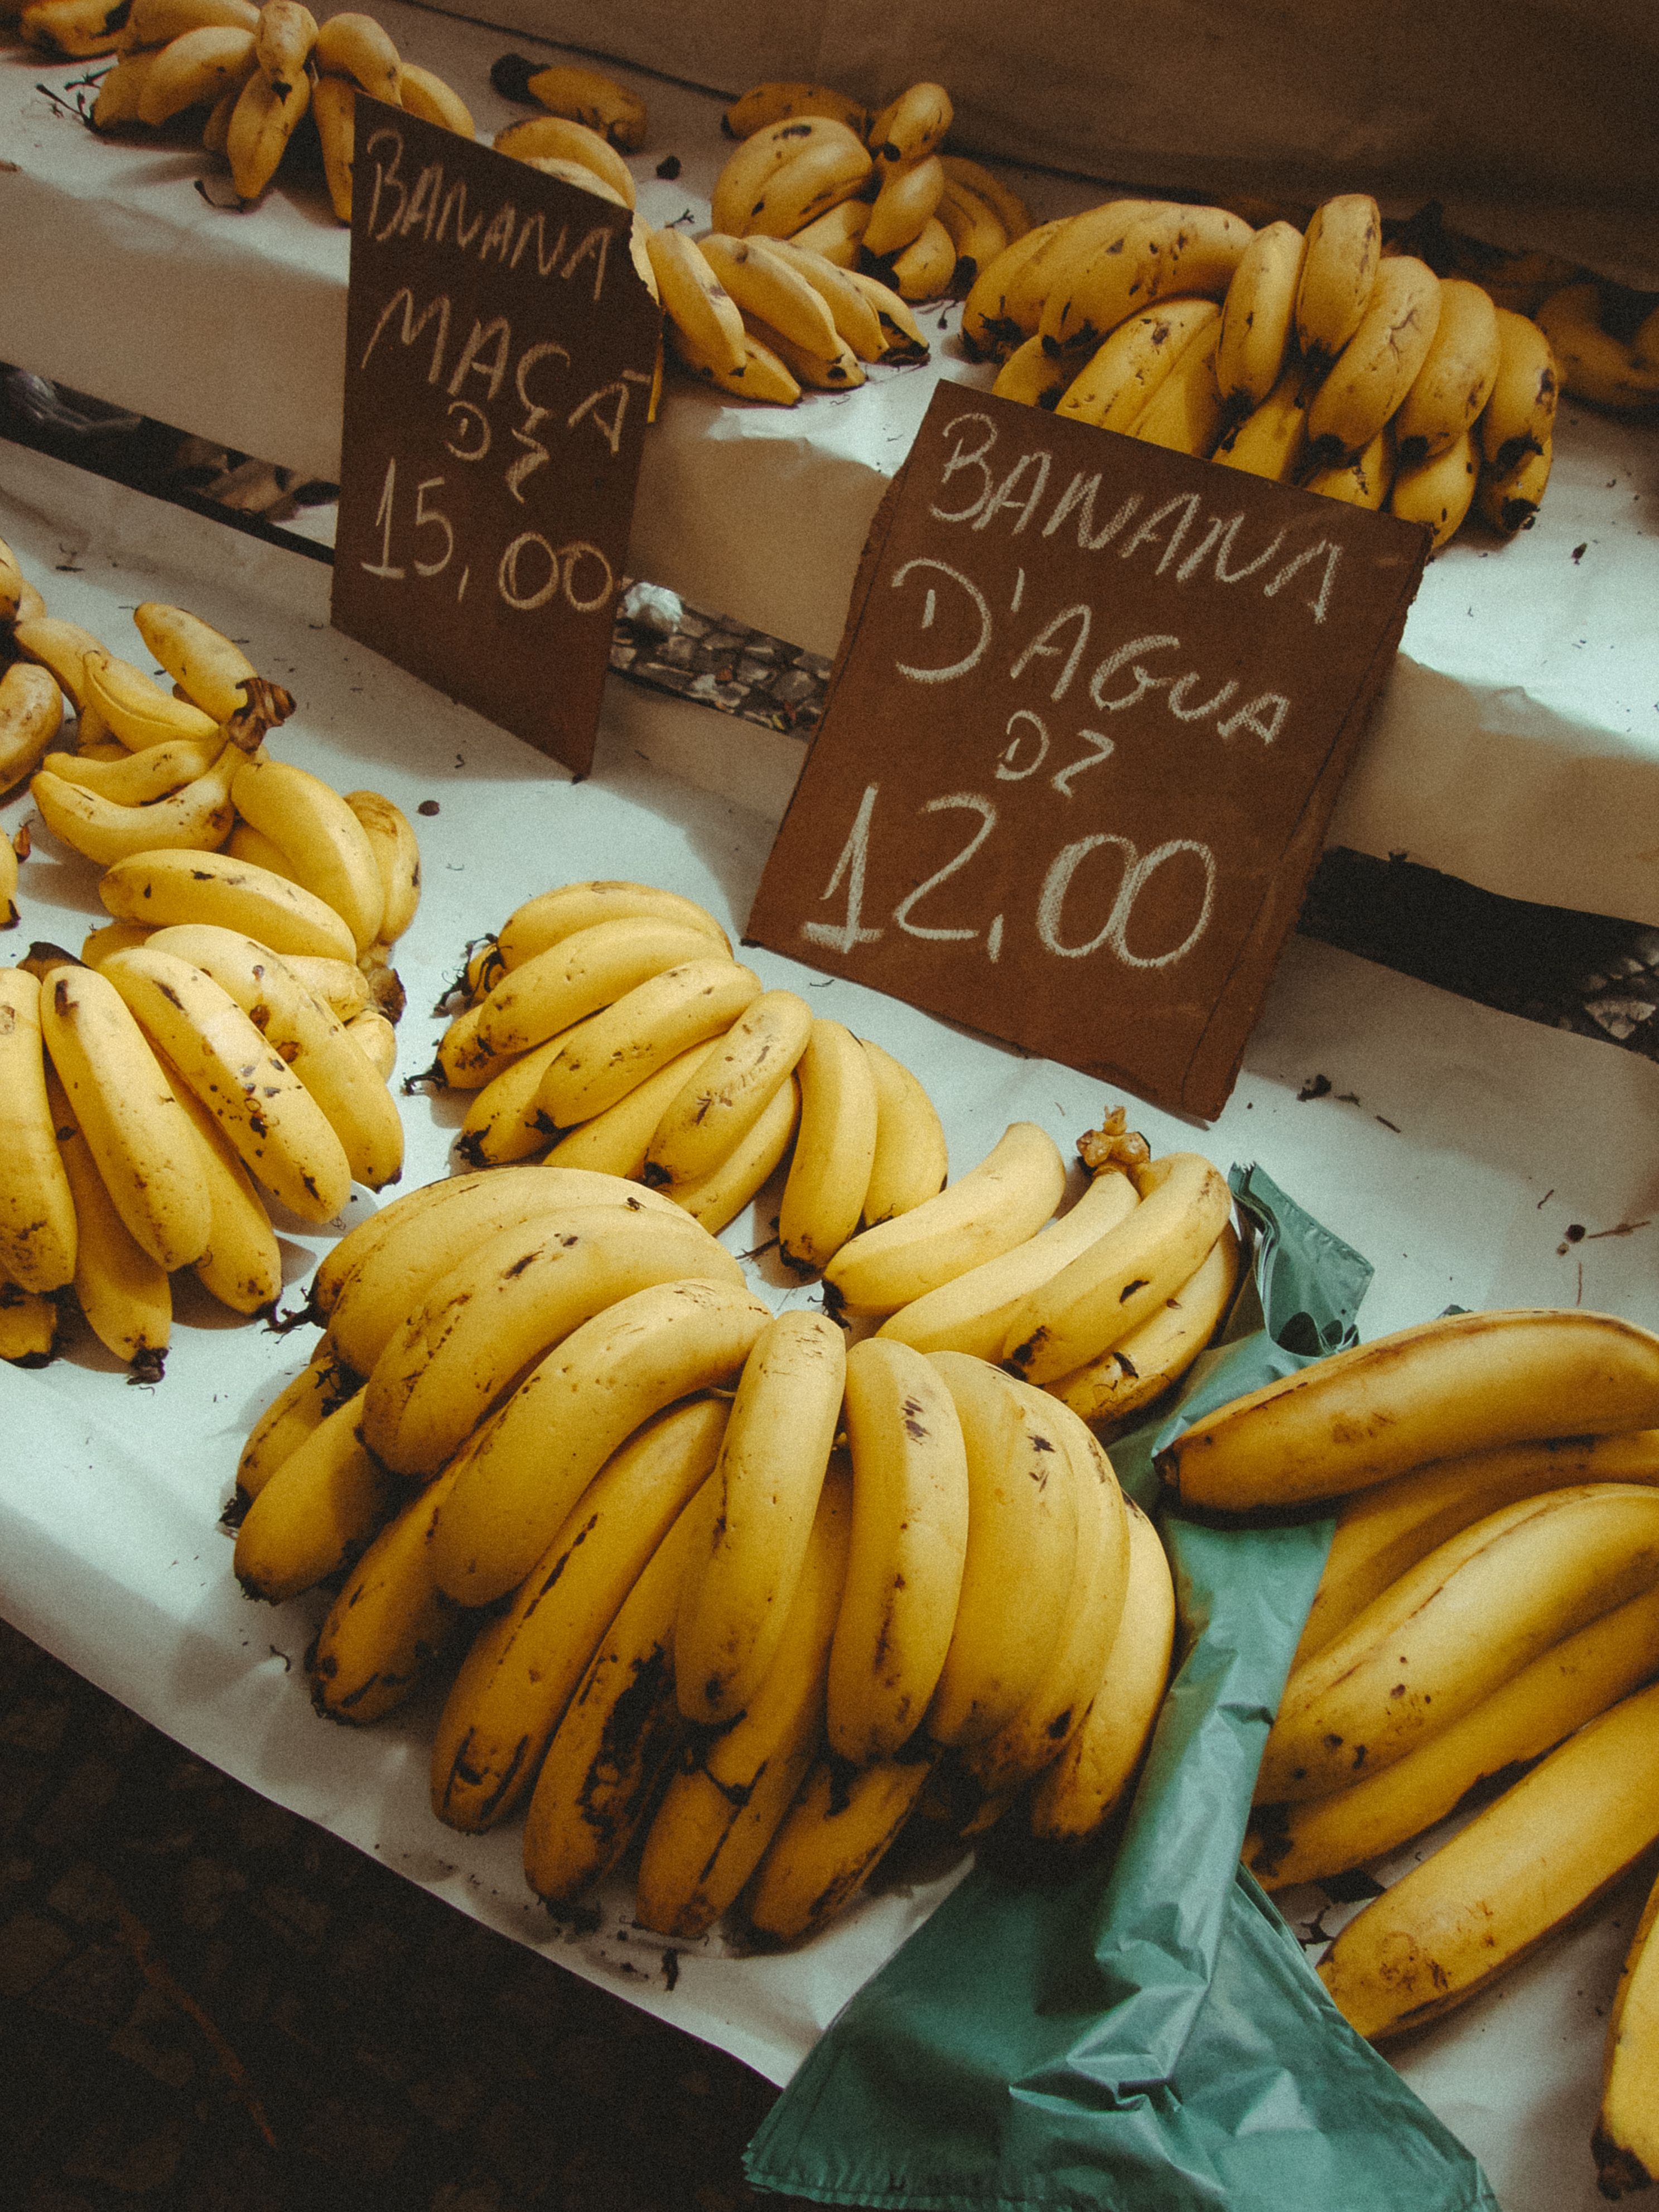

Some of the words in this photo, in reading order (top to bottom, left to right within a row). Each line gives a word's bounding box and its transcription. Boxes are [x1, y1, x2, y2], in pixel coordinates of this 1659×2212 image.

[366, 127, 611, 301] BANANA
[360, 457, 613, 612] 15,00
[931, 413, 1343, 624] BANANA
[891, 558, 1291, 744] D'AGUA
[995, 710, 1115, 797] DZ
[802, 782, 1217, 968] 12,00
